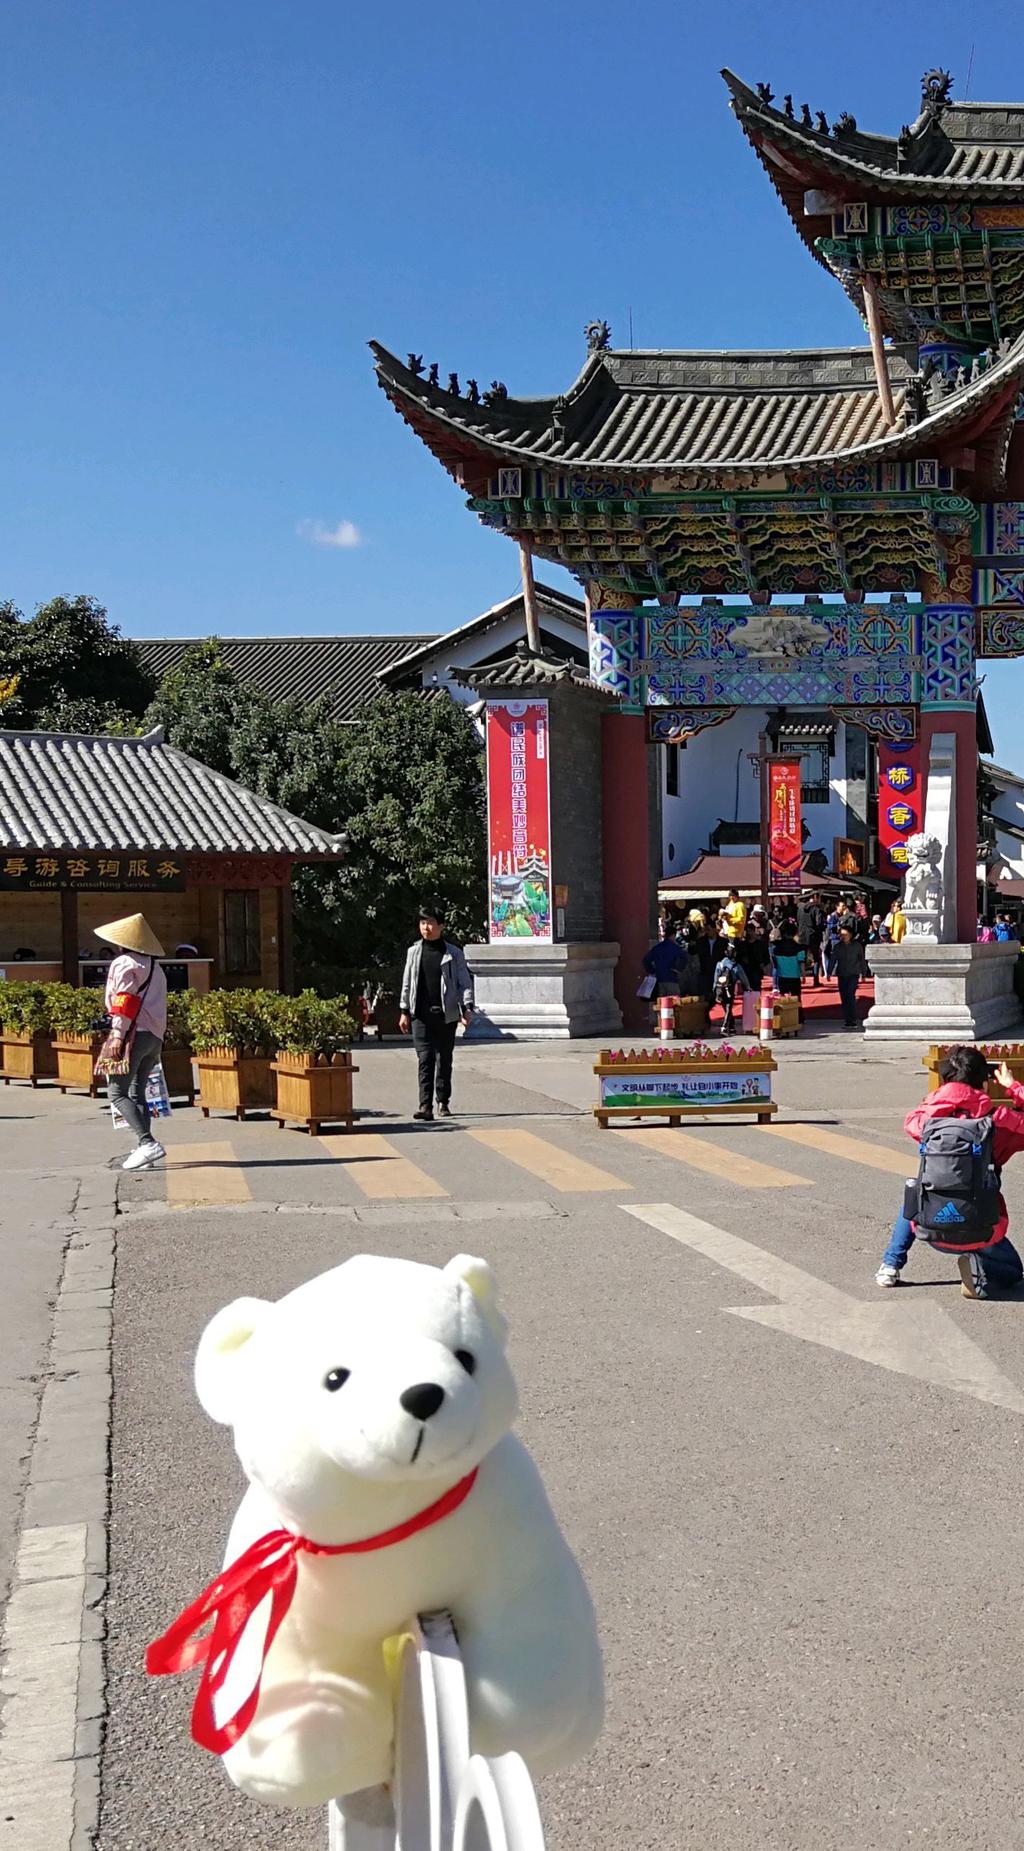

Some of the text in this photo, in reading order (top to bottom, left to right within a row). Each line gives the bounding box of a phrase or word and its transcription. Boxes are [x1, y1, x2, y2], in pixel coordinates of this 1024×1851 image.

[889, 767, 911, 863] 桥香园
[3, 858, 181, 878] 导游咨询服务
[29, 880, 57, 888] Guide
[933, 1213, 965, 1223] adidas
